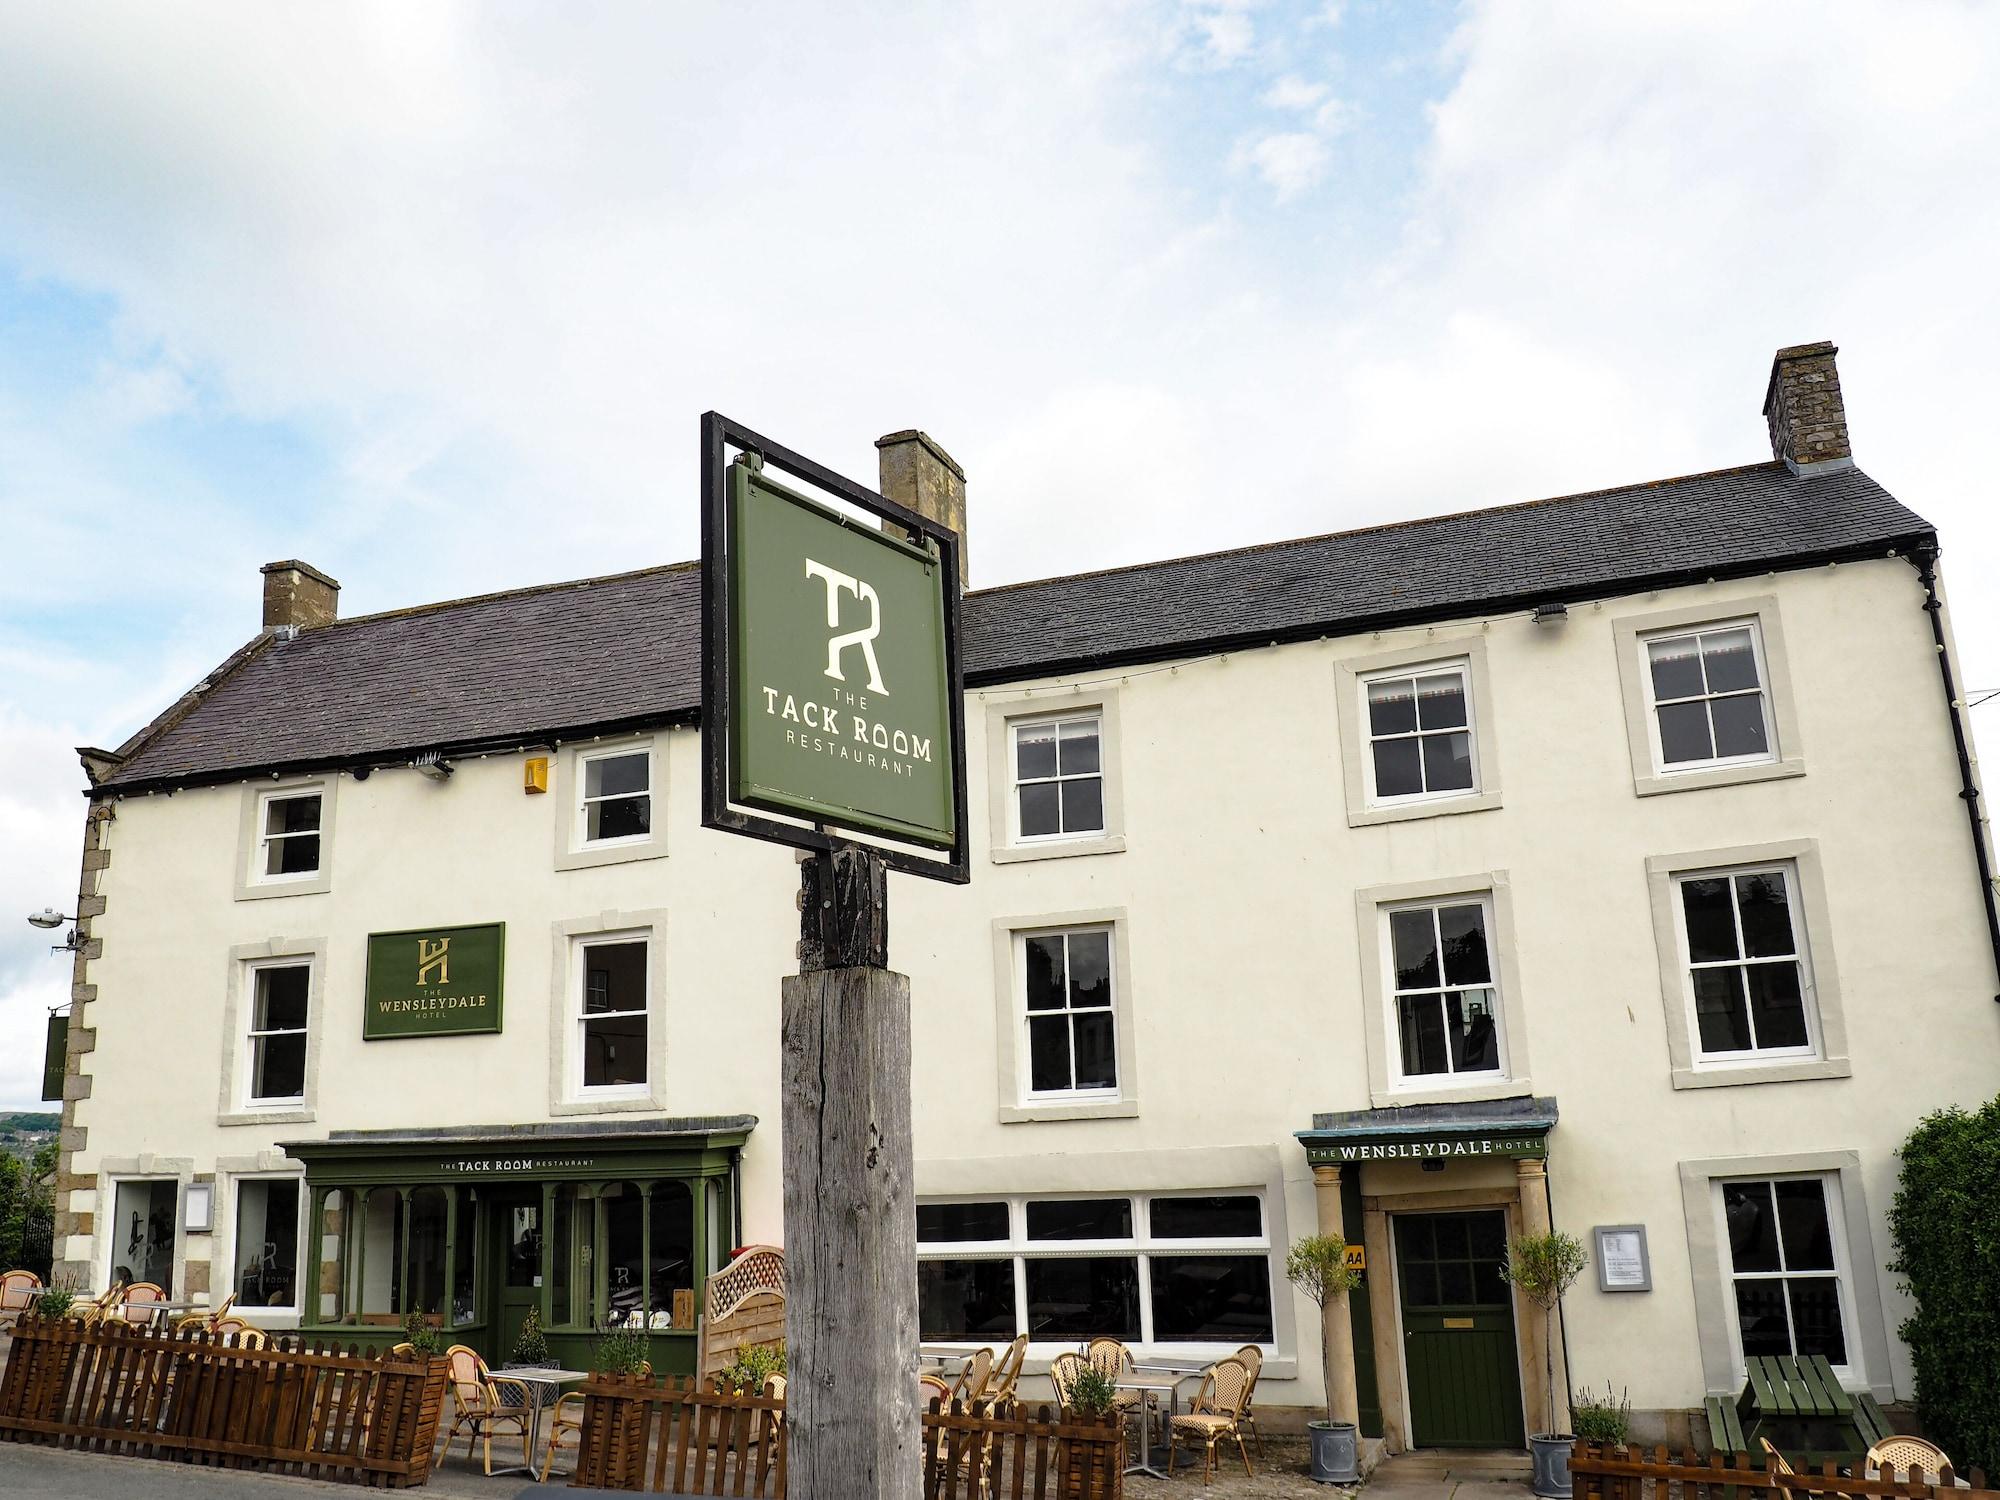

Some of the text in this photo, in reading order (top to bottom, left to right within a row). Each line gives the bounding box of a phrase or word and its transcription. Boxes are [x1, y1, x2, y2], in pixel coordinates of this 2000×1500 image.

[833, 687, 867, 710] THE
[763, 686, 932, 762] TACK ROOM
[787, 730, 913, 777] RESTAURANT
[423, 989, 441, 997] THE
[379, 995, 486, 1013] WENSLEYDALE
[1311, 1140, 1540, 1160] THE WENSLEYDALE HOTEL
[458, 1161, 490, 1171] TACK
[495, 1159, 533, 1171] ROOM
[536, 1159, 594, 1167] RESTAURANT
[1346, 1252, 1362, 1264] AA
